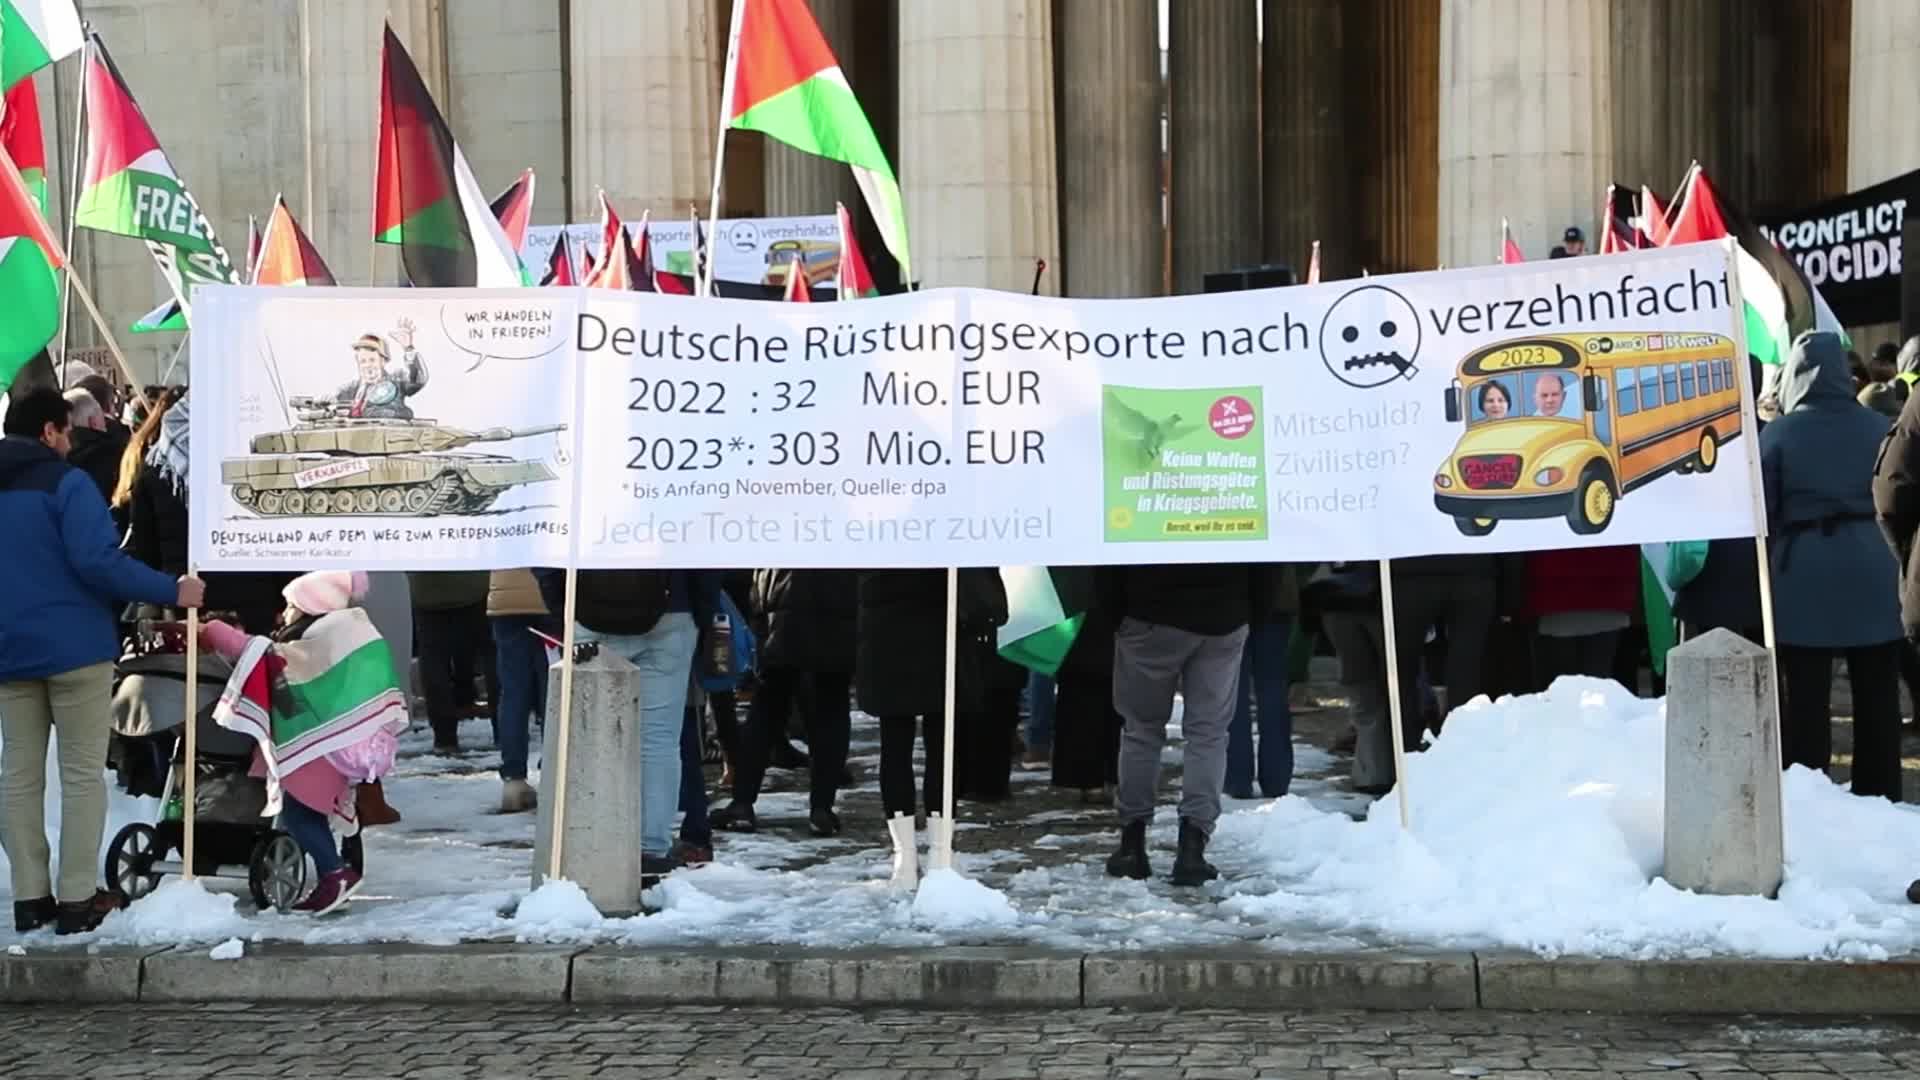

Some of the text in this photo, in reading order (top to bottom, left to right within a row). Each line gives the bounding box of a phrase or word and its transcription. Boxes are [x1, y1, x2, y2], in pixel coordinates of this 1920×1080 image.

[133, 184, 206, 240] FREE
[1779, 200, 1907, 249] CONFLICT
[761, 222, 840, 240] verzehnfach
[1796, 236, 1902, 286] OCIDE
[465, 310, 552, 322] WIR HANDELN
[469, 325, 551, 339] IN FRIEDEN!
[577, 268, 1731, 363] Deutsche Rüstungsexporte nach verzehnfacht
[1501, 349, 1546, 367] 2023
[627, 377, 727, 414] 2022
[771, 379, 817, 412] 32
[862, 371, 948, 407] Mio.
[962, 370, 1041, 406] EUR
[1272, 400, 1422, 438] Mitschuld?
[768, 431, 841, 466] 303
[865, 430, 952, 466] Mio.
[966, 430, 1046, 465] EUR
[1275, 441, 1411, 476] Zivilisten?
[664, 481, 731, 500] Anfang
[735, 478, 837, 498] November,
[841, 478, 907, 497] Quelle:
[910, 478, 947, 498] dpa
[1277, 485, 1380, 513] Kinder?
[211, 521, 569, 545] DEUTSCHLAND AUF DEM WEG ZUM FRIEDENSNOBELPREIS
[592, 507, 1053, 546] Jeder Tote ist einer zuviel
